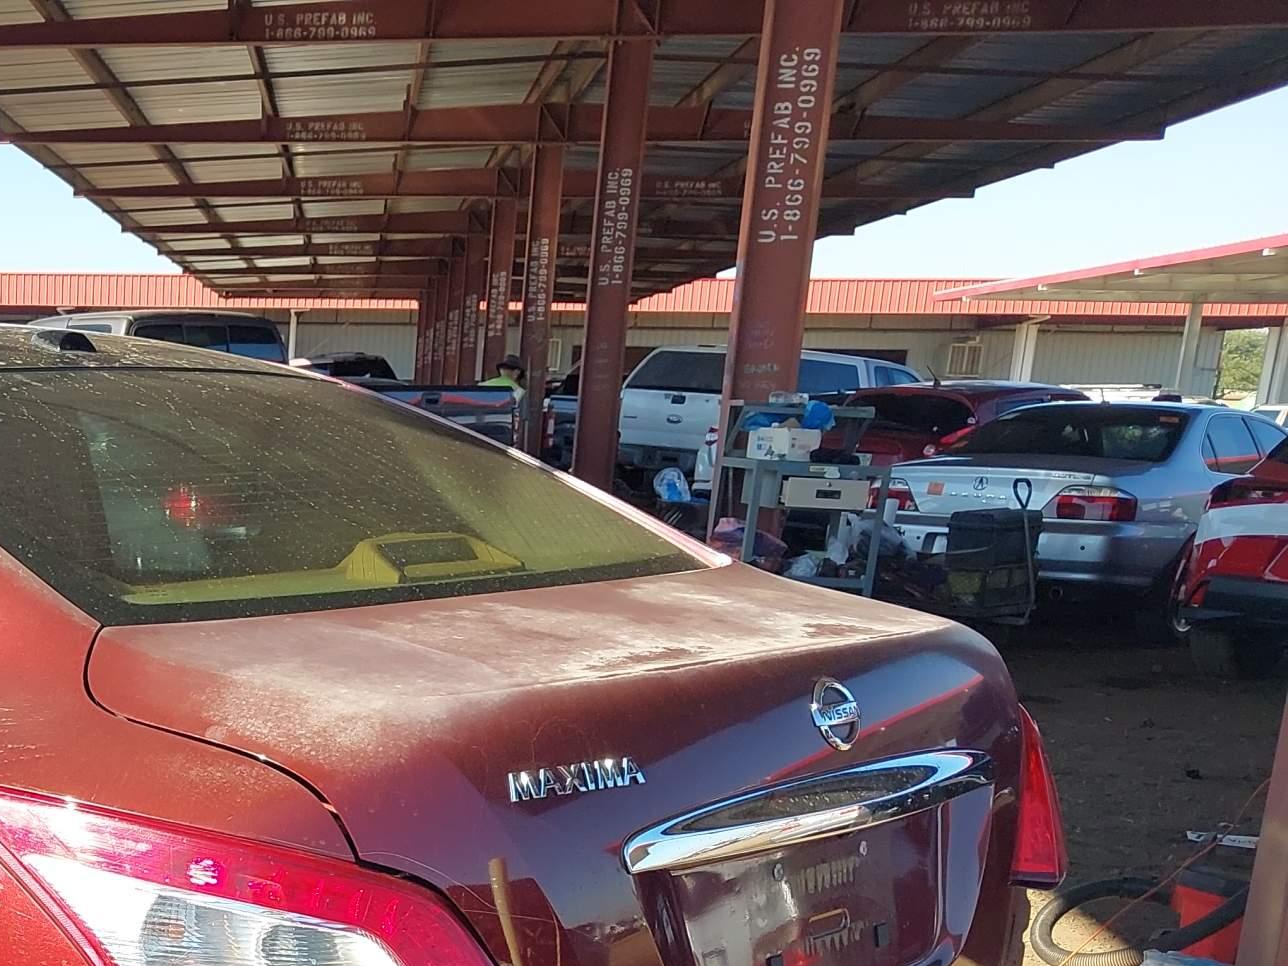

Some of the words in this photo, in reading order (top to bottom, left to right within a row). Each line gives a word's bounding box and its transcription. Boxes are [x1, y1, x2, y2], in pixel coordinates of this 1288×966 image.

[296, 12, 347, 26] PREFAB
[777, 46, 800, 88] INC.
[765, 101, 793, 188] PREFAB
[780, 47, 822, 240] 1-866-799-0969
[606, 167, 621, 193] INC.
[601, 200, 617, 253] PREFAB
[611, 168, 633, 284] 1-866-799-0969
[758, 201, 781, 243] U.S.
[598, 259, 611, 286] U.S.
[507, 757, 646, 803] MAXIMA
